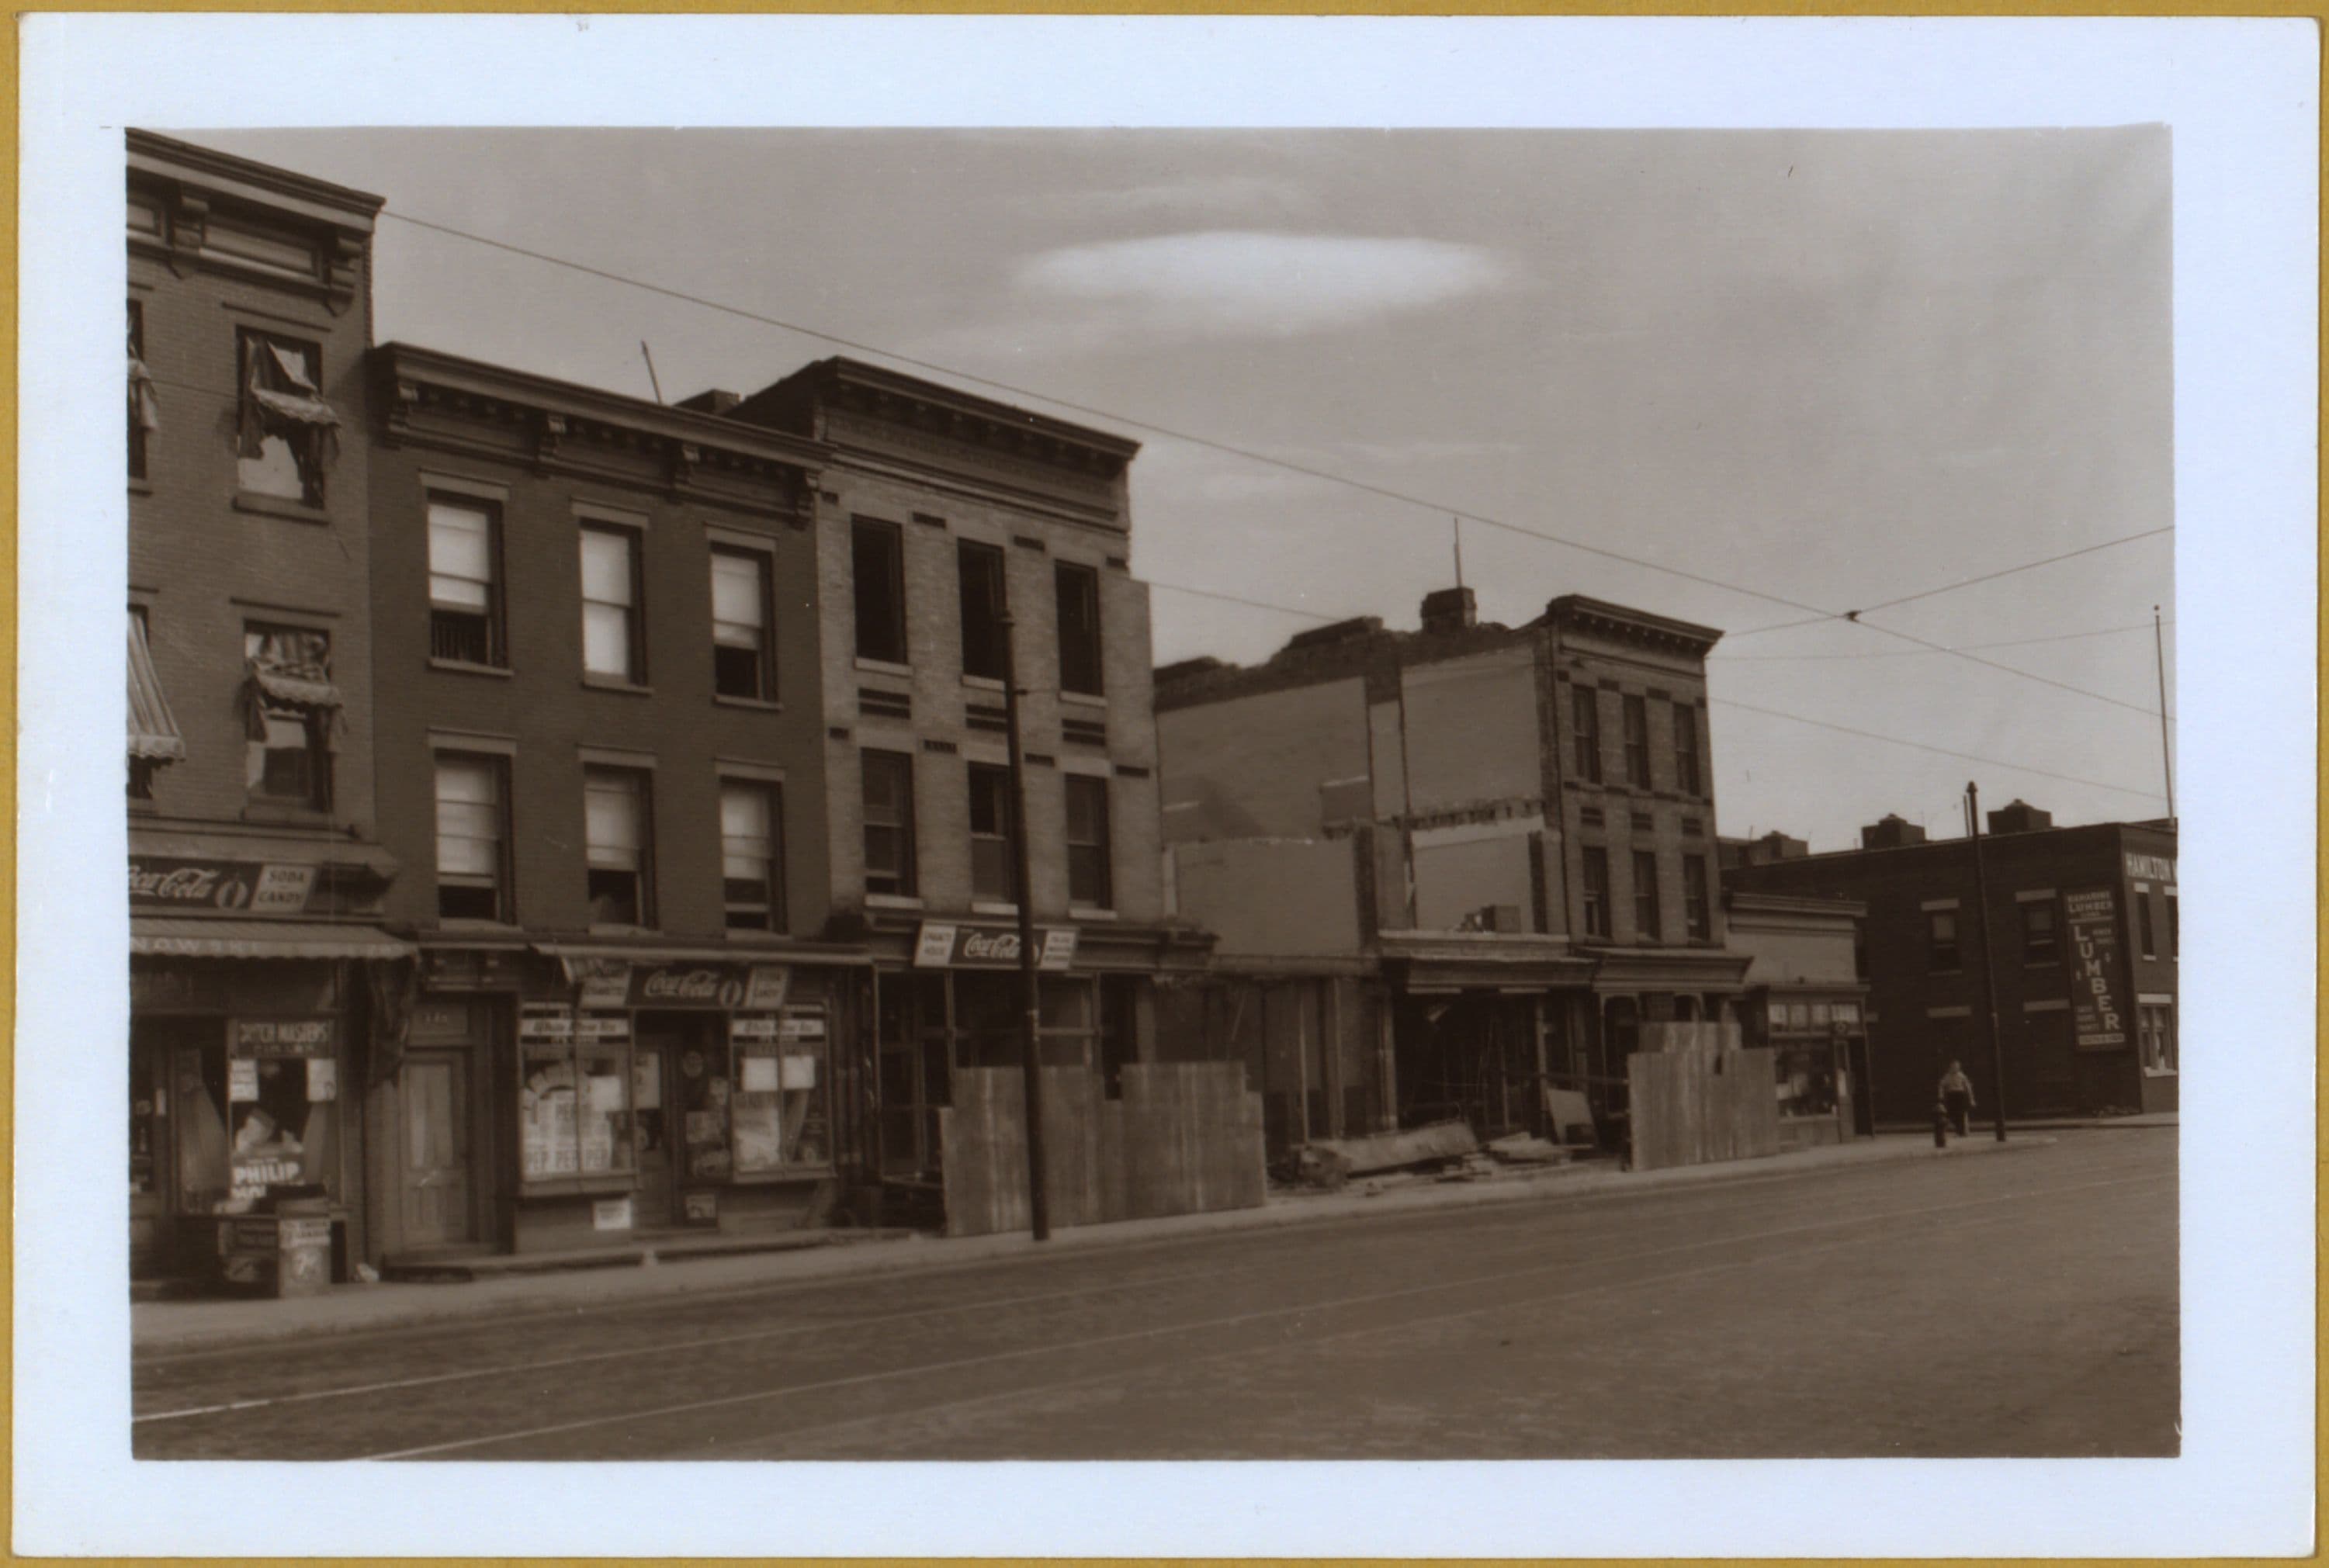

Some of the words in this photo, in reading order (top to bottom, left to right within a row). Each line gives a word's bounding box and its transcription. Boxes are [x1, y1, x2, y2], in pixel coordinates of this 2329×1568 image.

[269, 871, 305, 882] SODA
[644, 970, 719, 998] Coca-Cola
[2074, 926, 2121, 1030] LUMBER
[233, 1161, 299, 1185] PHILIP
